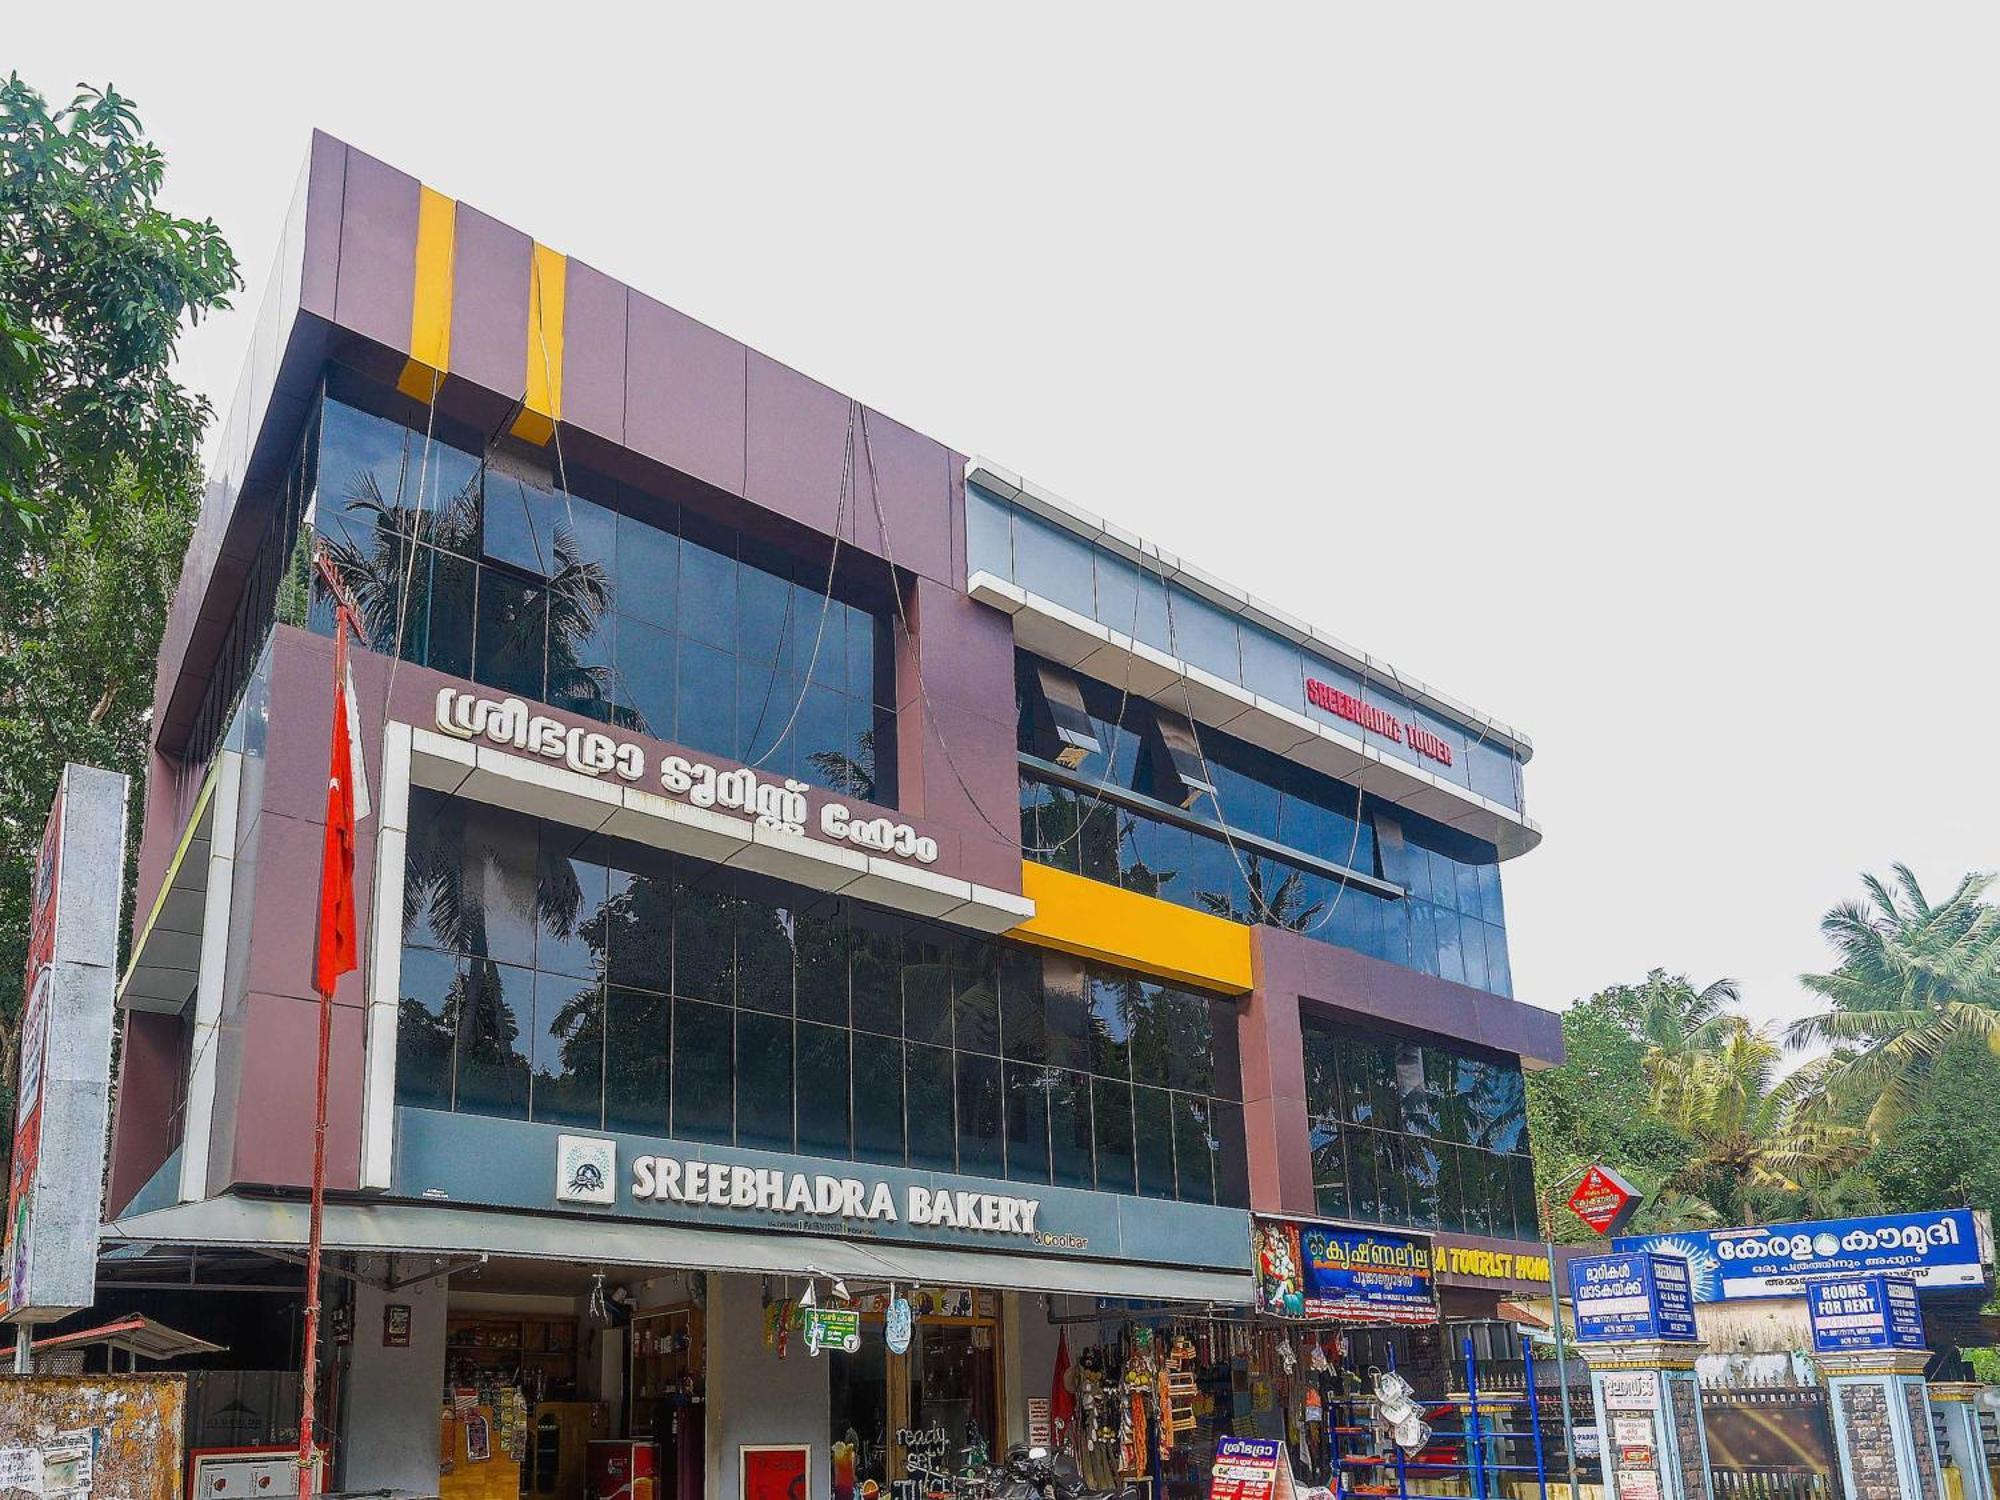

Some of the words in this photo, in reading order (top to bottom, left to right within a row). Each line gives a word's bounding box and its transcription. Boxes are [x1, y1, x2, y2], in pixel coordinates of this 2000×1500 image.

[1405, 724, 1453, 767] TOWER
[820, 803, 938, 864] ഹോം
[631, 1155, 898, 1222] SREEBHADRA
[908, 1185, 1040, 1234] BAKERY
[1043, 1232, 1089, 1249] Coolbar
[1717, 1235, 1814, 1260] കേരള
[1449, 1248, 1513, 1279] TOURIST
[1515, 1255, 1550, 1282] HOM
[1818, 1301, 1842, 1315] FOR
[1844, 1298, 1876, 1313] RENT
[1822, 1284, 1868, 1300] ROOMS
